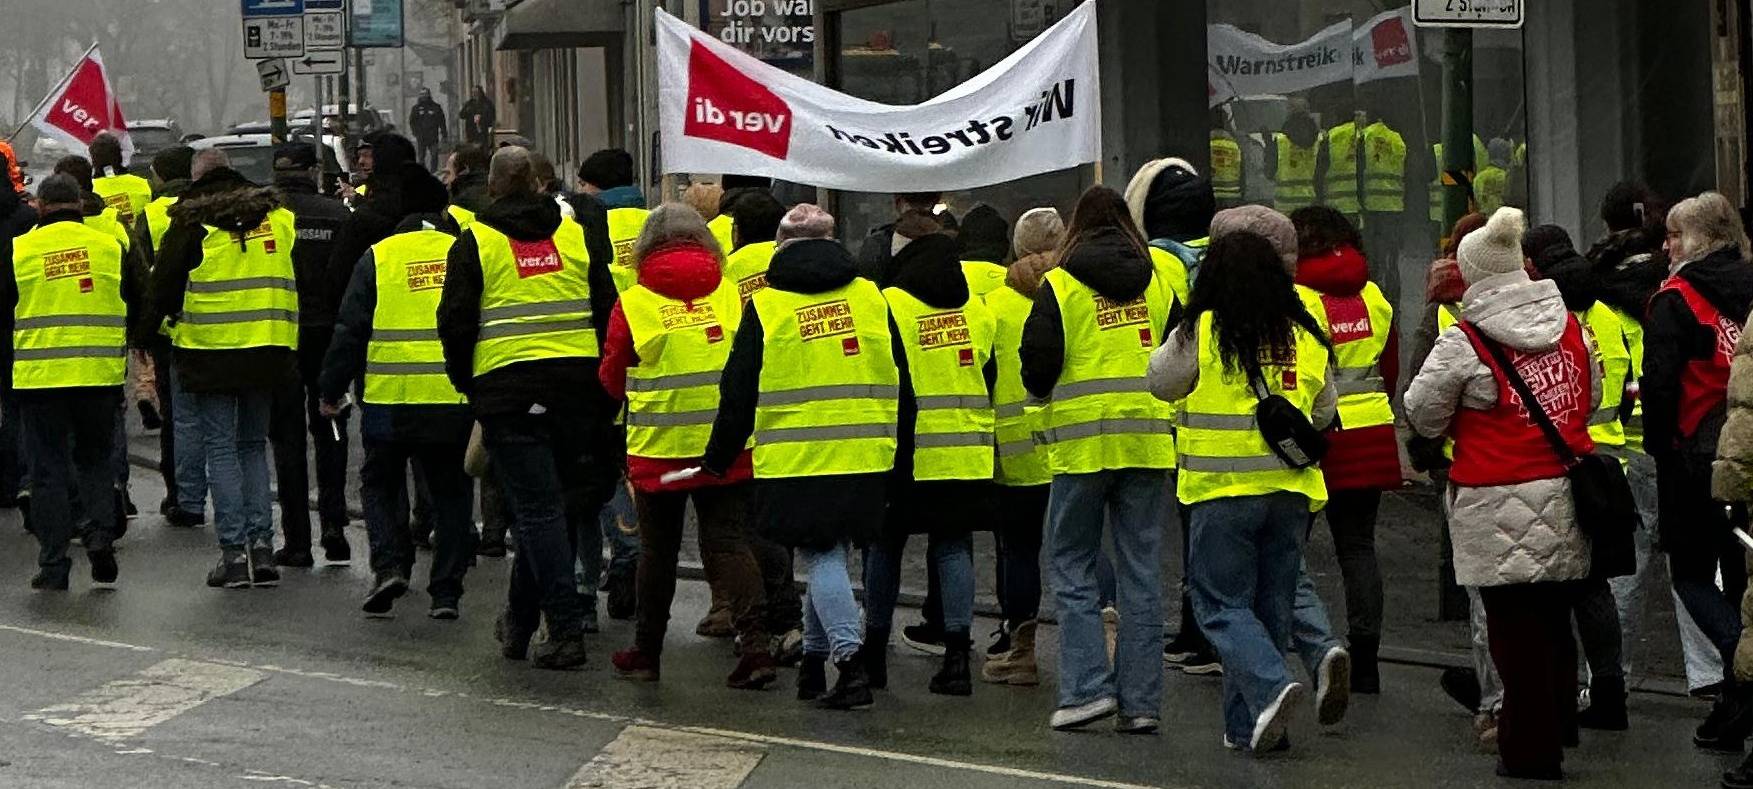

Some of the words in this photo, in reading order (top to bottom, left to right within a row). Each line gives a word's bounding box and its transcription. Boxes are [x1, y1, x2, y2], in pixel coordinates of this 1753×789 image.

[720, 0, 765, 16] Job
[720, 21, 754, 42] dir
[1216, 46, 1337, 75] Warnstreik
[797, 302, 851, 323] ZUSAMMEN
[1097, 310, 1121, 326] GEHT
[800, 321, 825, 338] GEHT
[828, 316, 855, 332] MEHR
[917, 314, 967, 332] ZUSAMMEN
[1332, 318, 1369, 334] ver.di
[919, 331, 943, 347] GEHT
